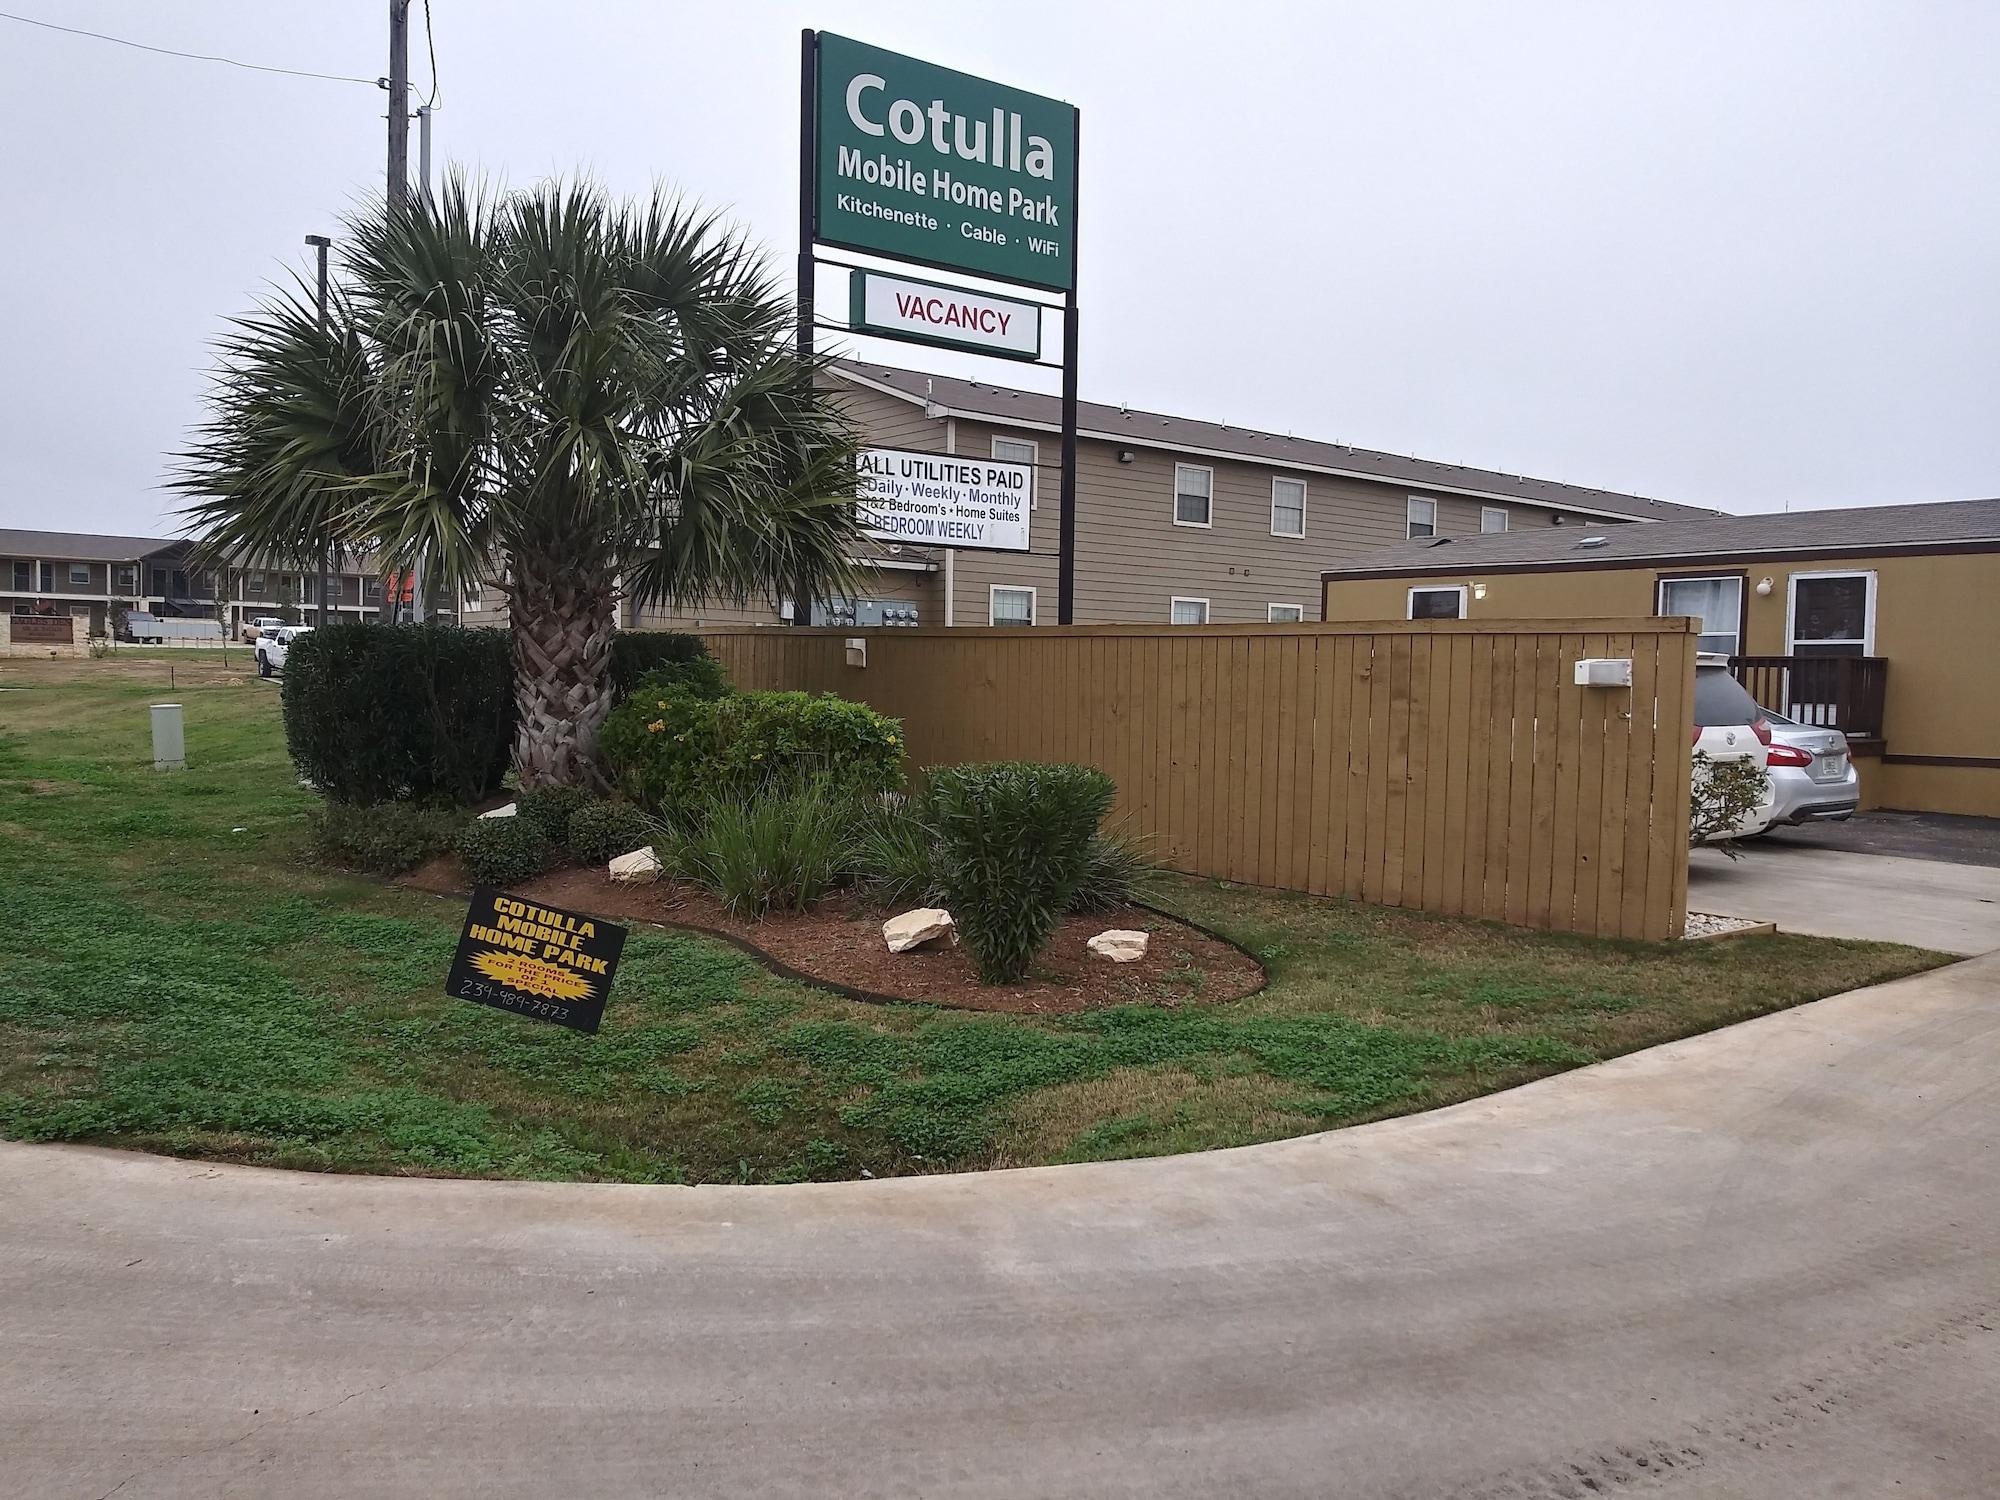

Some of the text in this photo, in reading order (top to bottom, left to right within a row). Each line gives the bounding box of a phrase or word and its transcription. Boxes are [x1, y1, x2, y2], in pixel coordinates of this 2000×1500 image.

[845, 73, 1054, 181] Cotulla
[837, 145, 1059, 227] Mobile Home Park
[837, 193, 1059, 257] Kitchenette Cable WiFi
[896, 292, 1011, 335] VACANCY
[860, 455, 1023, 489] ALL UTILITIES PAID
[867, 479, 1021, 509] Daily Weekly Monthly
[889, 498, 946, 515] Bedroom's
[956, 505, 986, 519] Home
[989, 508, 1020, 522] Suites
[874, 515, 934, 536] BEDROOM
[937, 520, 984, 540] WEEKLY
[493, 897, 595, 939] COTULLA
[497, 914, 585, 952] MOBILE
[469, 923, 609, 976] HOME PARK
[487, 959, 581, 988] FOR THE PRICE
[507, 977, 560, 994] SPECIAL
[519, 961, 565, 977] ROOMS
[521, 974, 535, 982] OF
